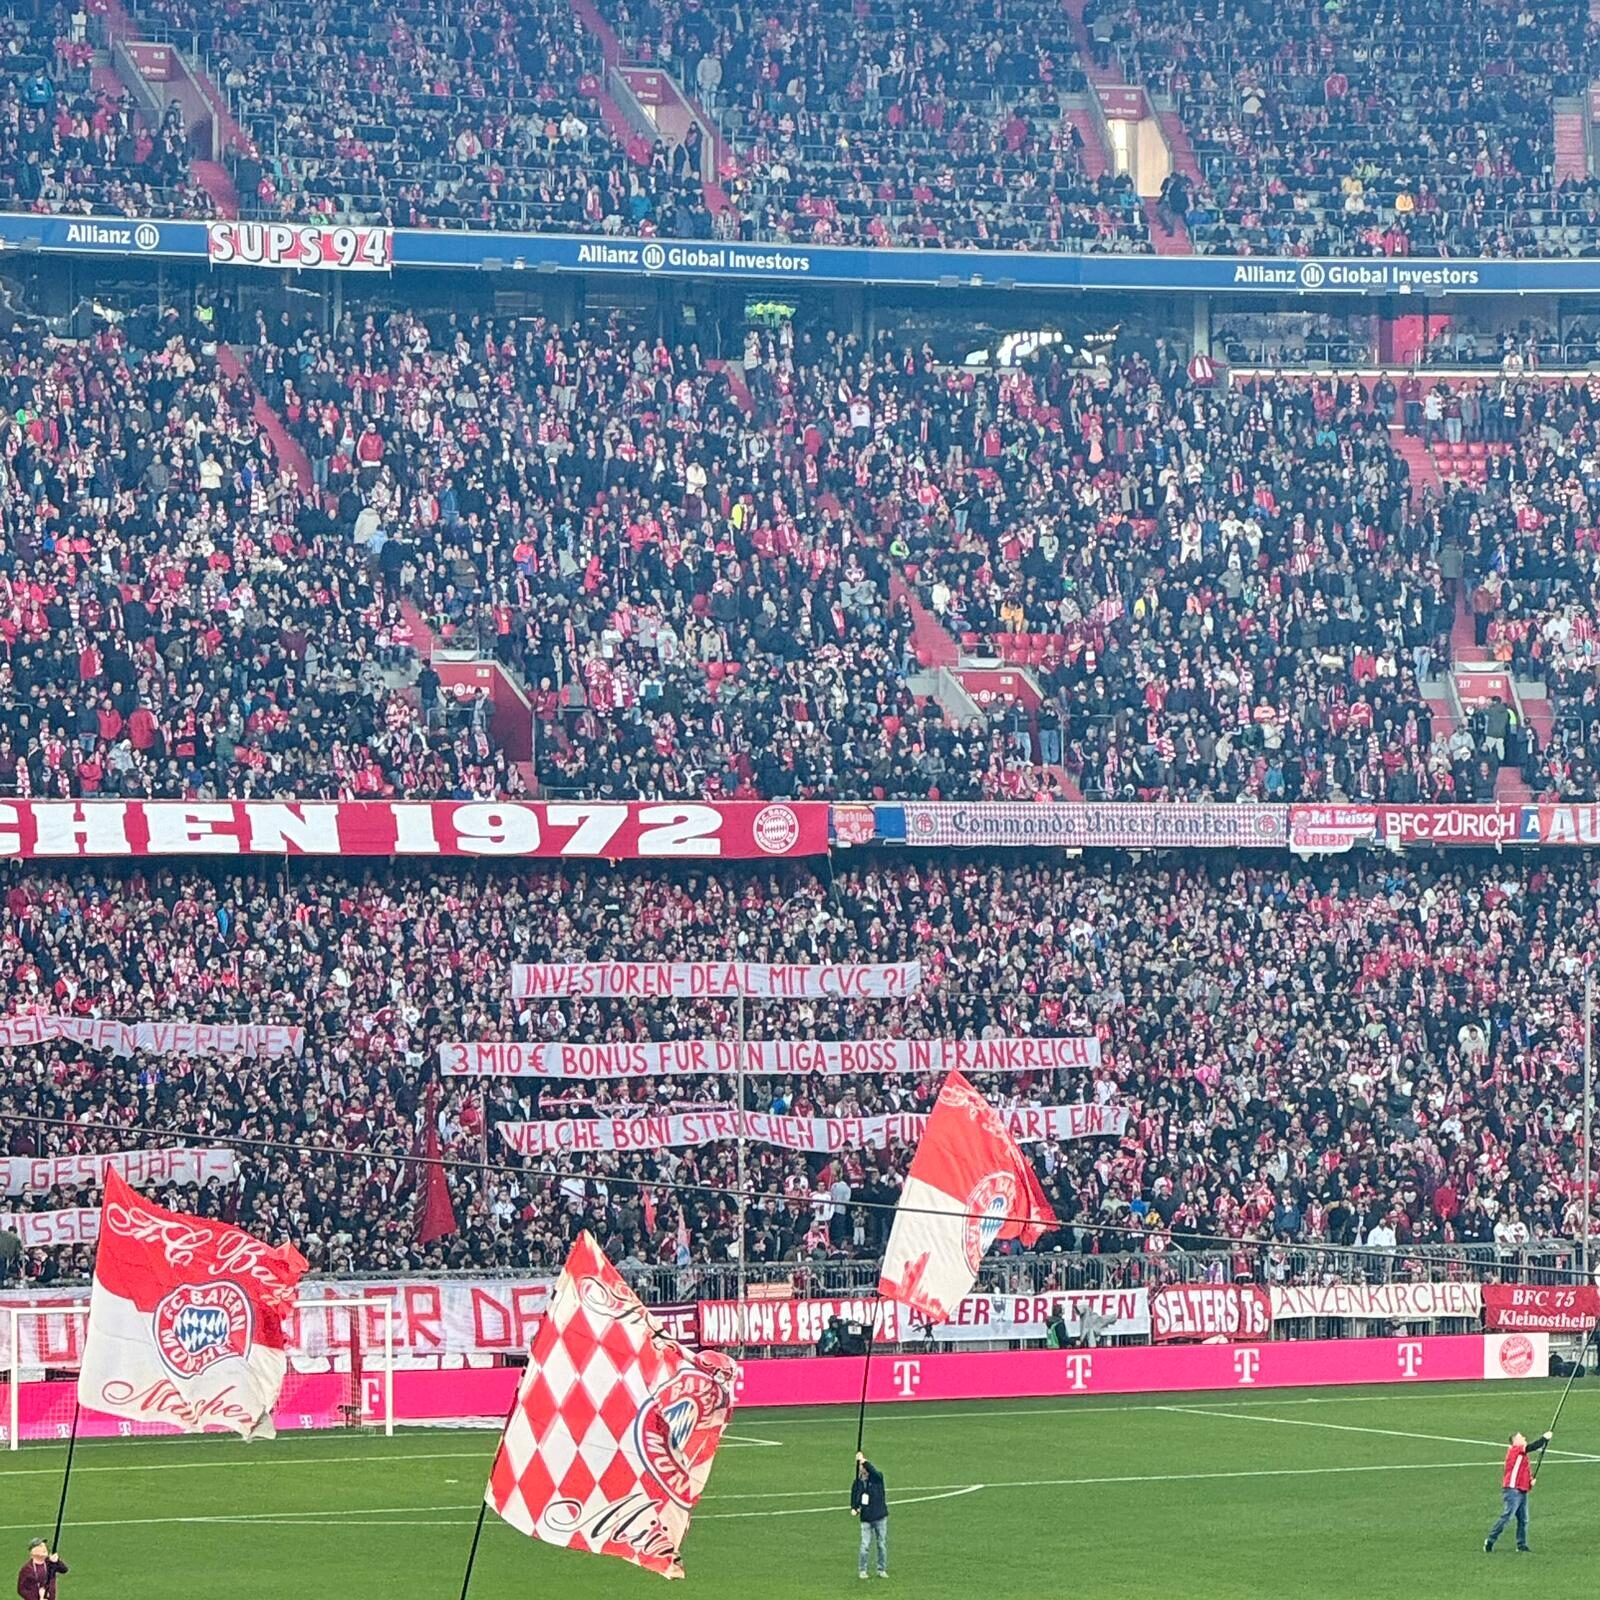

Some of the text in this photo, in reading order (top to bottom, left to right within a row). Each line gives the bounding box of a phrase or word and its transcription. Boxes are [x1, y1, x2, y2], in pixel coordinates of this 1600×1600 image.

[67, 224, 130, 244] Allianz
[210, 224, 387, 266] SUPS 94
[578, 245, 810, 271] Allianz Global Investors
[1234, 265, 1479, 284] Allianz Global Investors
[390, 803, 723, 854] 1972
[952, 810, 1075, 833] Commando
[1386, 810, 1515, 837] BFC ZÜRICH
[526, 963, 754, 996] INVESTOREN-DEAL
[769, 966, 807, 996] MIT
[819, 966, 872, 996] CVC
[451, 1045, 468, 1073] 3
[477, 1044, 521, 1073] MIO
[527, 1045, 548, 1073] €
[562, 1046, 648, 1075] BONUS
[775, 1041, 897, 1072] LIGA-BOSS
[909, 1040, 930, 1070] IN
[942, 1038, 1089, 1070] FRANKREICH
[506, 1119, 603, 1154] WELCHE
[612, 1116, 673, 1149] BONI
[1069, 1105, 1104, 1136] EIN
[163, 1287, 246, 1332] FC BAYERN
[908, 1297, 990, 1326] AER
[1155, 1288, 1241, 1334] SELTERS
[1278, 1283, 1478, 1314] ANZENKIRCHEN
[1512, 1289, 1576, 1308] BFC 75
[1497, 1308, 1596, 1328] Kleinostheim
